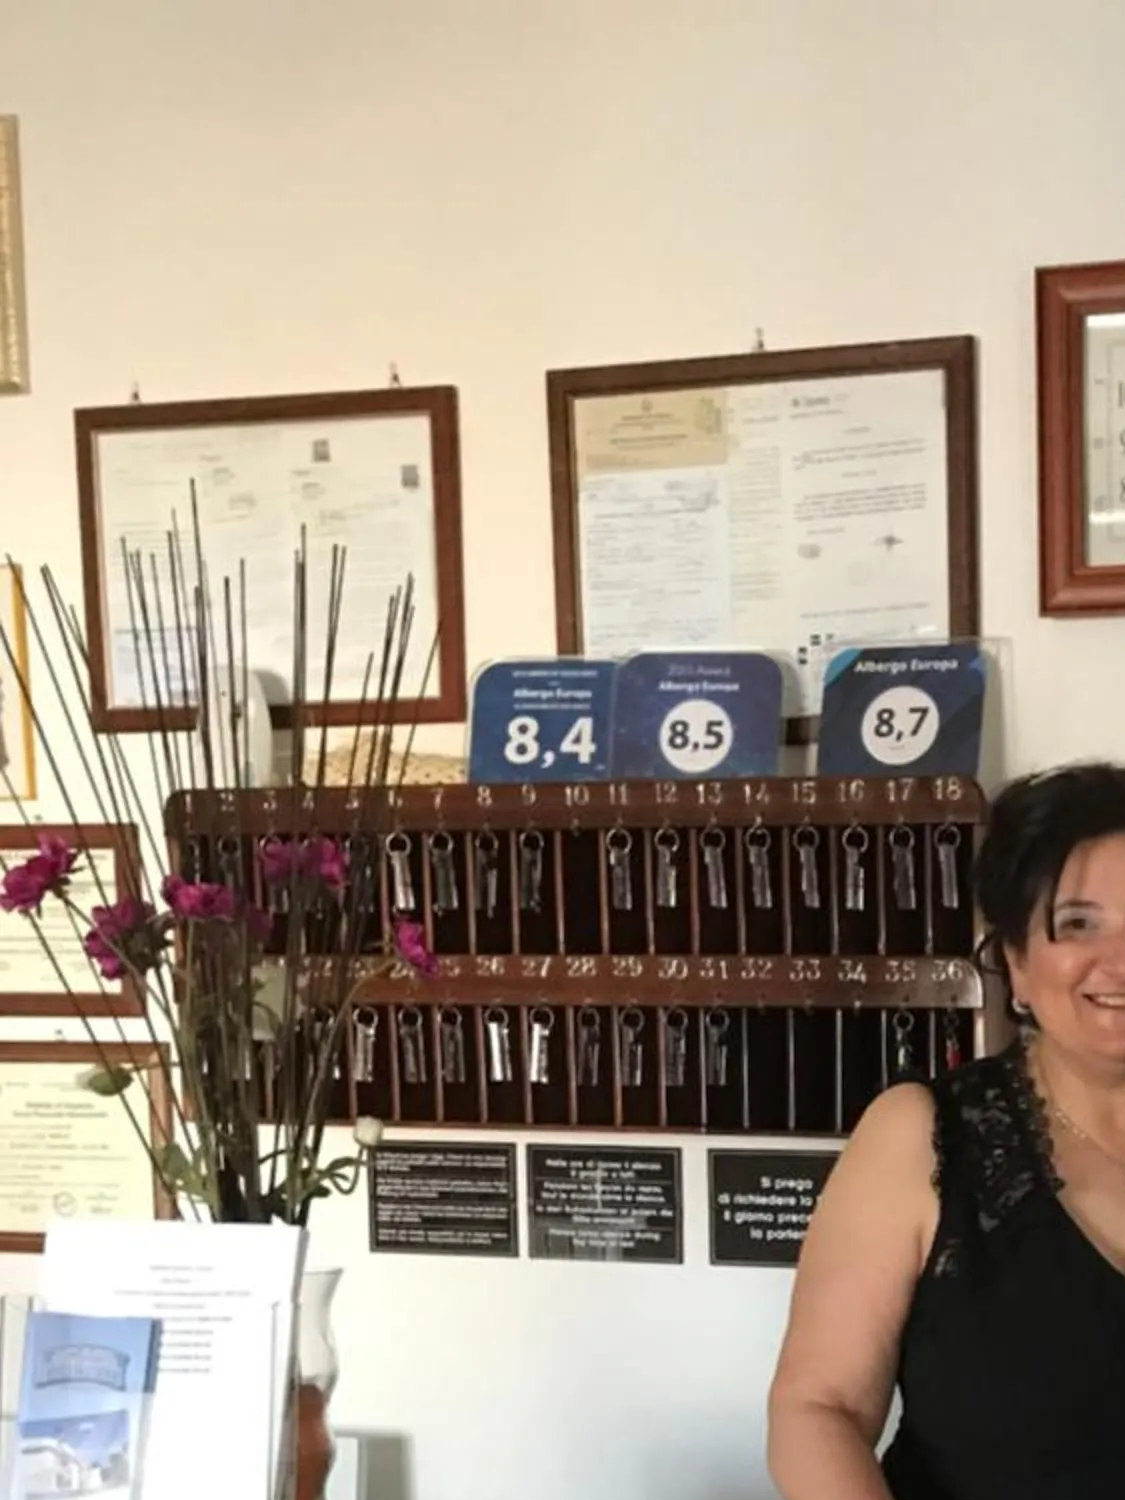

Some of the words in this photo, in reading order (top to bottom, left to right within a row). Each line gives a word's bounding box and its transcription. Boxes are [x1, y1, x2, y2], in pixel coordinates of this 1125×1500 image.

[852, 659, 907, 675] Albergo
[910, 658, 959, 673] Europa
[513, 688, 554, 700] Albergo
[556, 687, 593, 699] Europa
[659, 681, 700, 694] Albergo
[702, 680, 739, 693] Europa
[873, 706, 930, 742] 8,7
[504, 715, 598, 769] 8,4
[668, 720, 724, 752] 8,5
[429, 788, 444, 810] 7
[477, 785, 492, 808] 8
[521, 783, 537, 805] 9
[565, 784, 590, 806] 10
[609, 783, 628, 805] 11
[655, 782, 678, 804] 12
[697, 782, 722, 804] 13
[743, 783, 770, 804] 14
[793, 781, 817, 804] 15
[838, 779, 865, 803] 16
[887, 778, 915, 802] 17
[934, 777, 963, 801] 18
[476, 956, 505, 977] 26
[522, 956, 552, 978] 27
[566, 956, 597, 977] 28
[612, 956, 643, 977] 29
[658, 957, 689, 979] 30
[700, 957, 729, 979] 31
[740, 958, 773, 980] 32
[789, 959, 822, 981] 33
[838, 960, 868, 983] 34
[885, 960, 917, 982] 35
[931, 959, 964, 981] 36
[760, 1176, 771, 1189] Si
[733, 1193, 797, 1207] richiedere
[734, 1210, 775, 1224] giorno
[777, 1212, 812, 1225] prece
